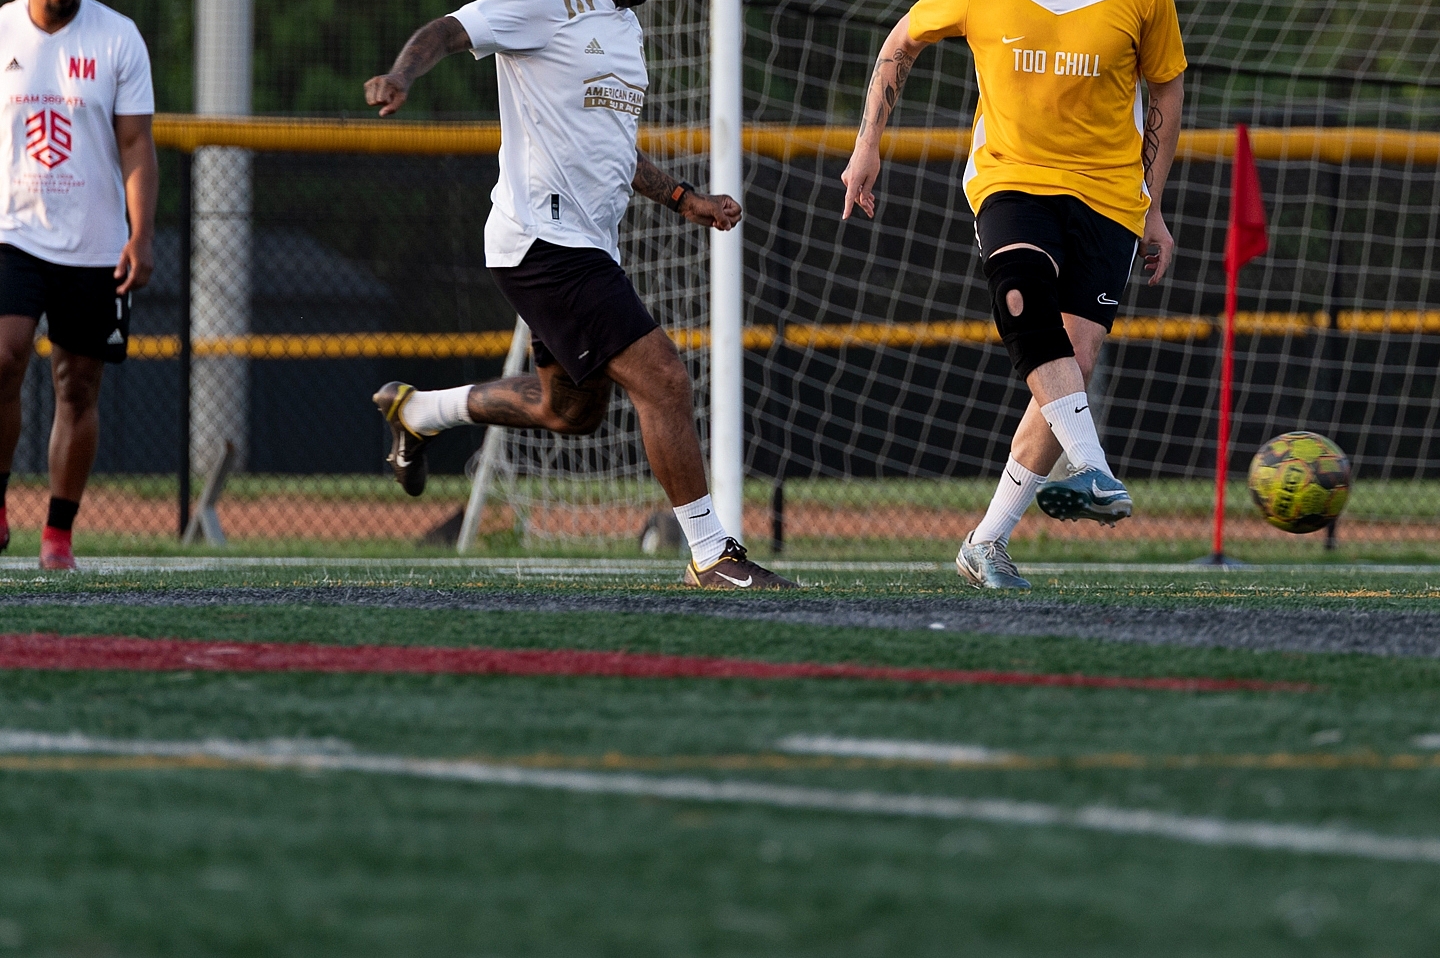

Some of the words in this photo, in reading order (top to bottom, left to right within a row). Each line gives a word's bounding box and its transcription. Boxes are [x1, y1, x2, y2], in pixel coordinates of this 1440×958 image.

[1012, 48, 1047, 74] TOO
[1054, 51, 1101, 77] CHILL
[585, 86, 627, 102] AMERICAN
